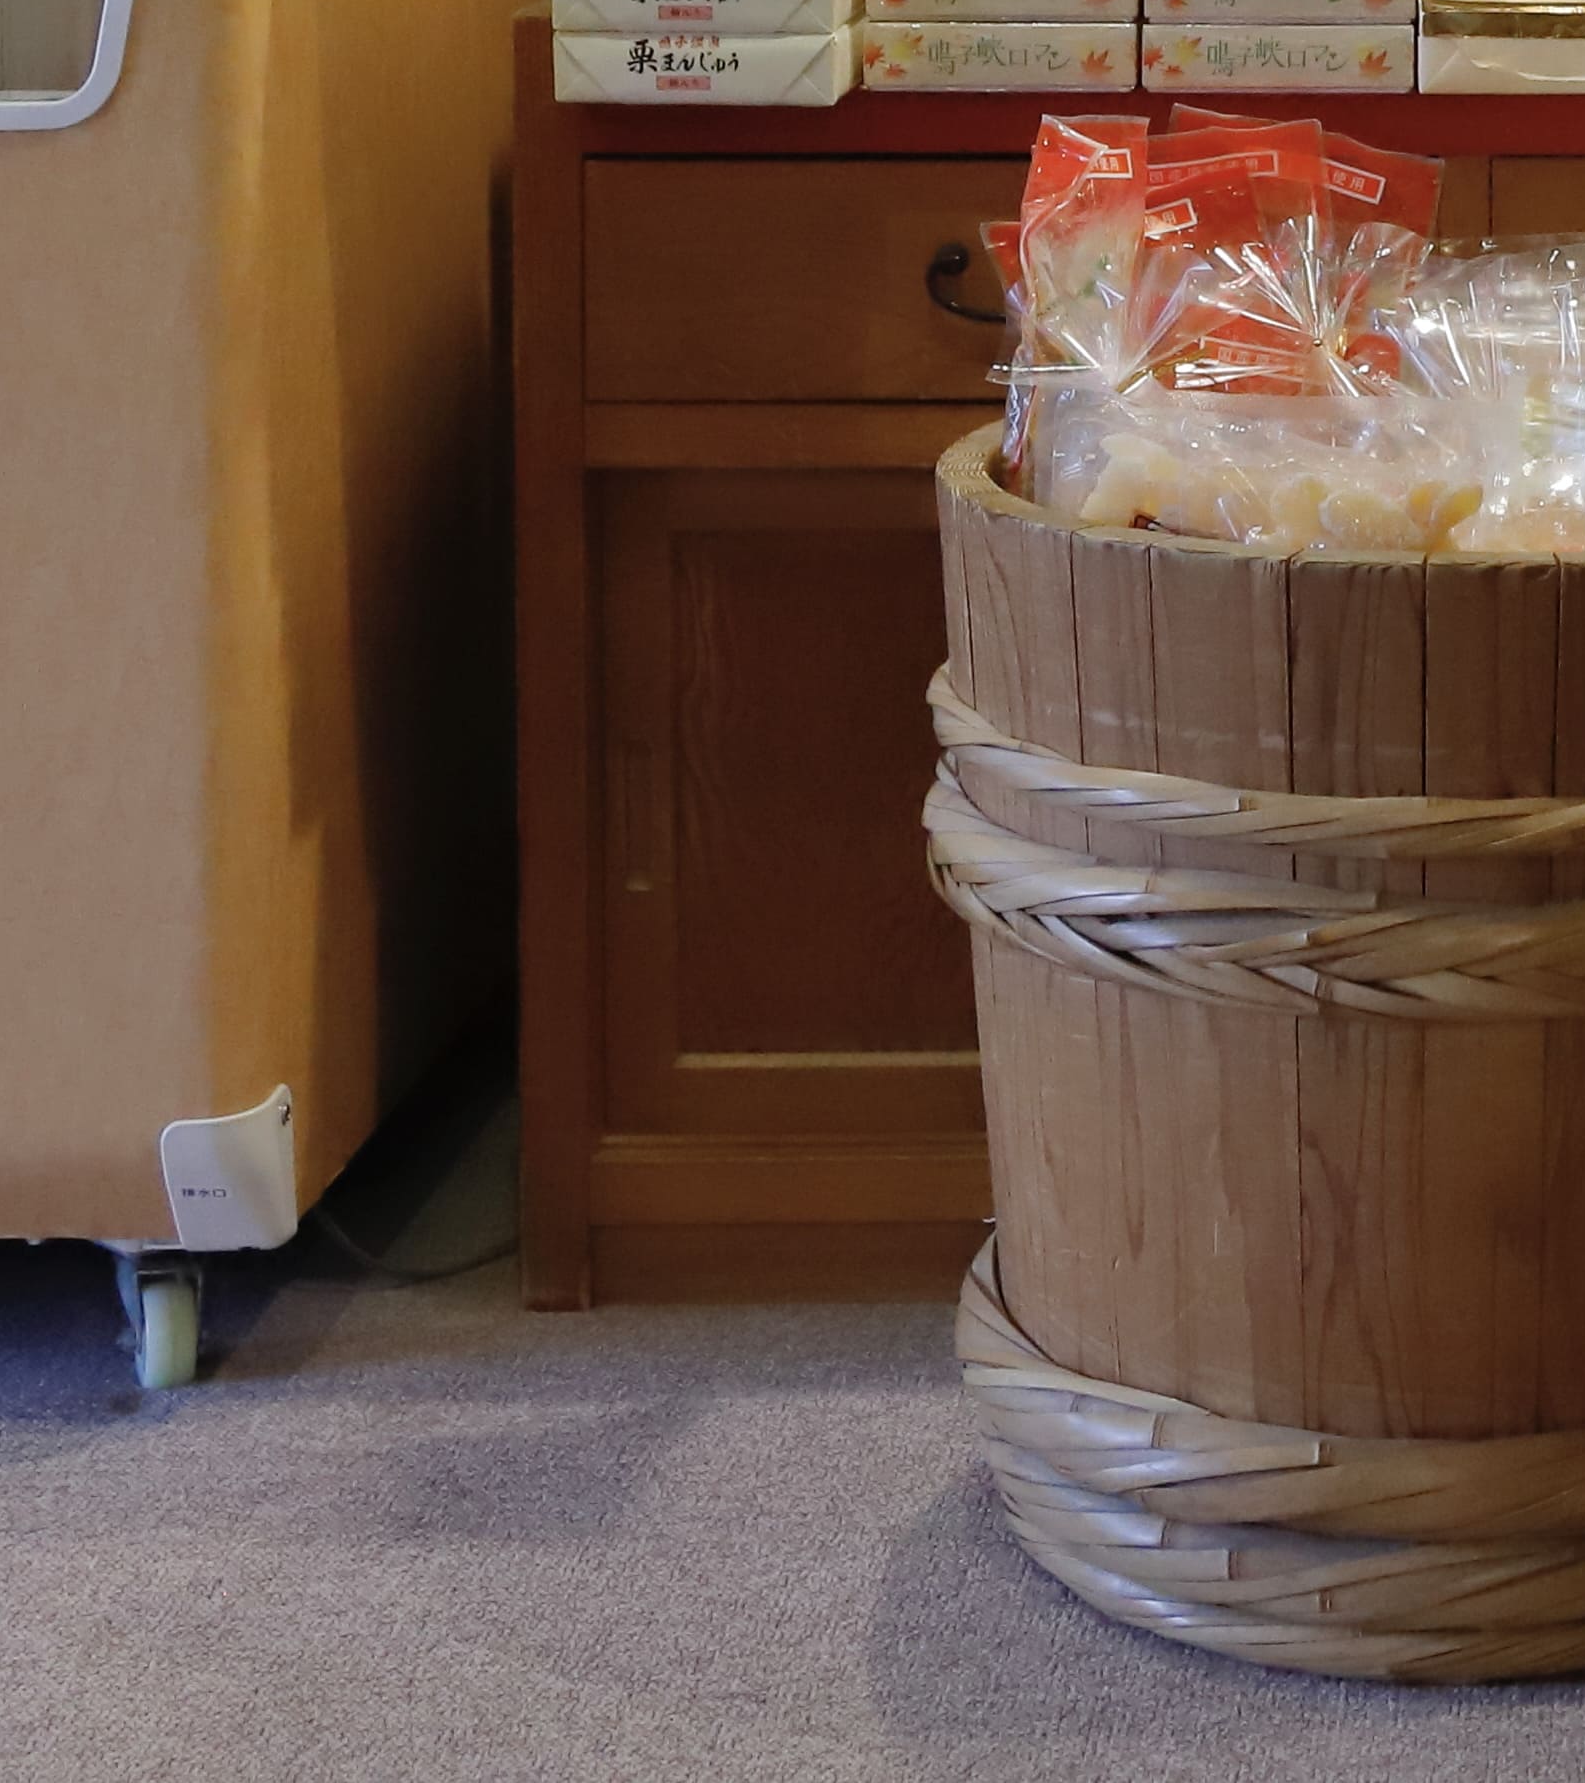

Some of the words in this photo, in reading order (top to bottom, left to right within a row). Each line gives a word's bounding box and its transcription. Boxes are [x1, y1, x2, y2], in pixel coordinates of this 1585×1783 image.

[627, 40, 740, 74] 栗まんじゅう
[928, 36, 1069, 76] 鳴子峡ロマン
[1207, 37, 1349, 76] 鳴子峡ロマン
